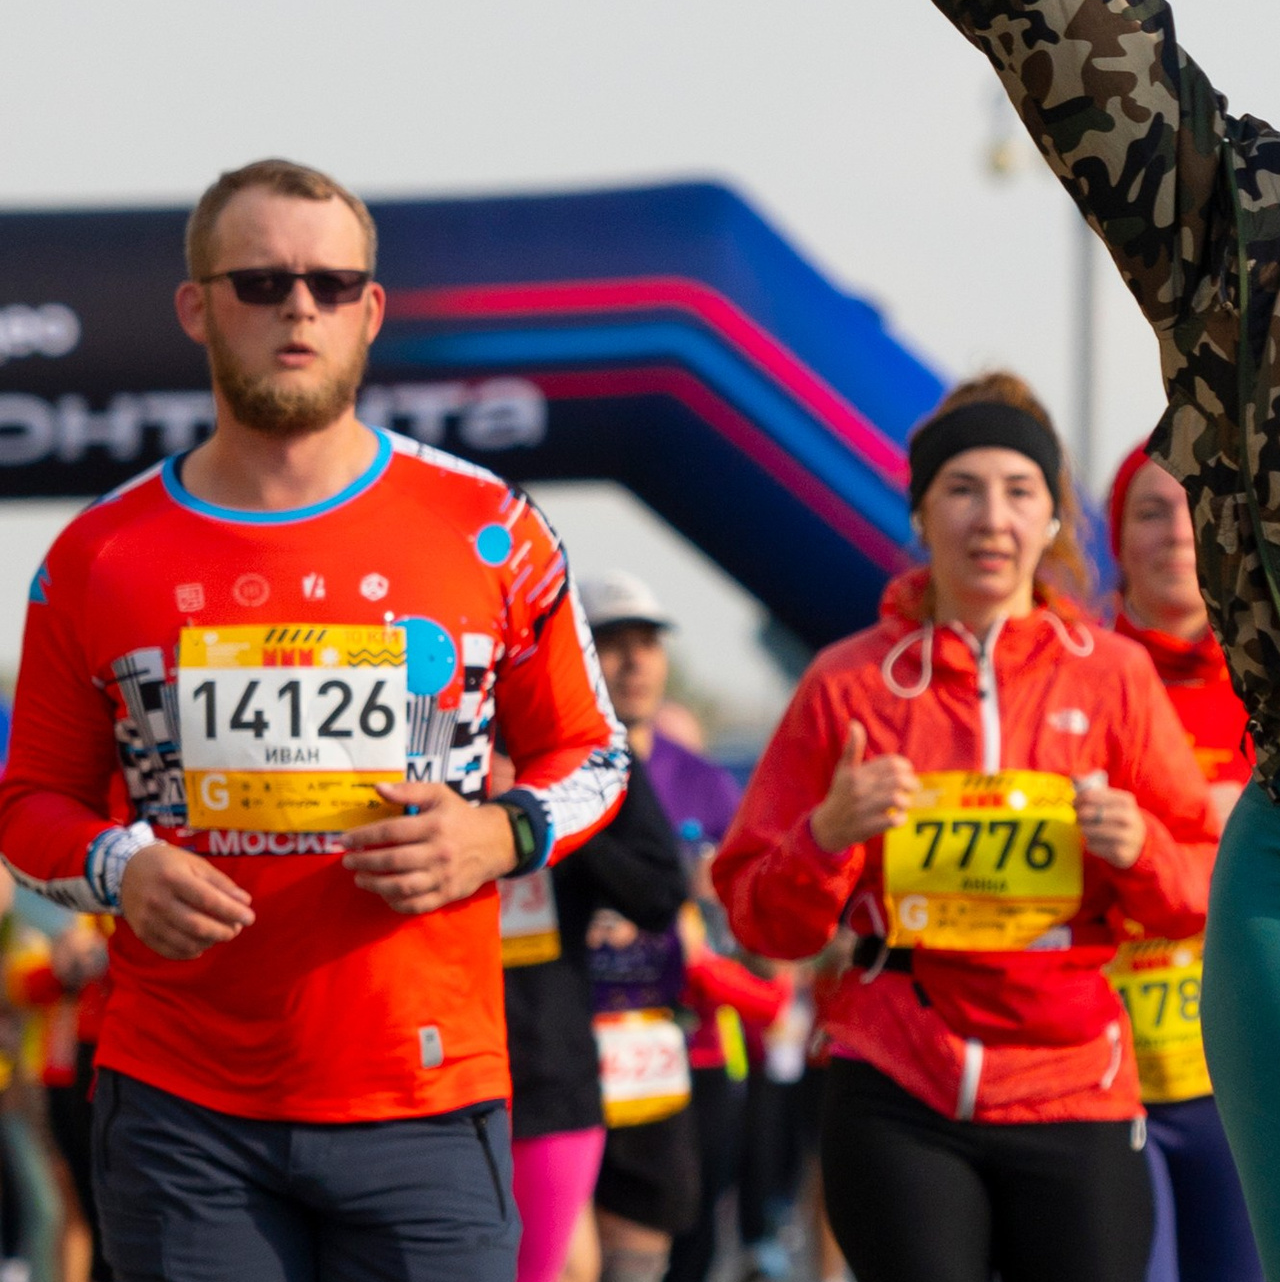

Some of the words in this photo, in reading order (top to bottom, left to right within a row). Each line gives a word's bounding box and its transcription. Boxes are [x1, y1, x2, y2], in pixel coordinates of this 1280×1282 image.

[193, 679, 396, 739] 14126
[264, 747, 320, 764] ИВАН
[200, 772, 230, 811] G
[915, 820, 1056, 871] 7776
[900, 894, 928, 930] G
